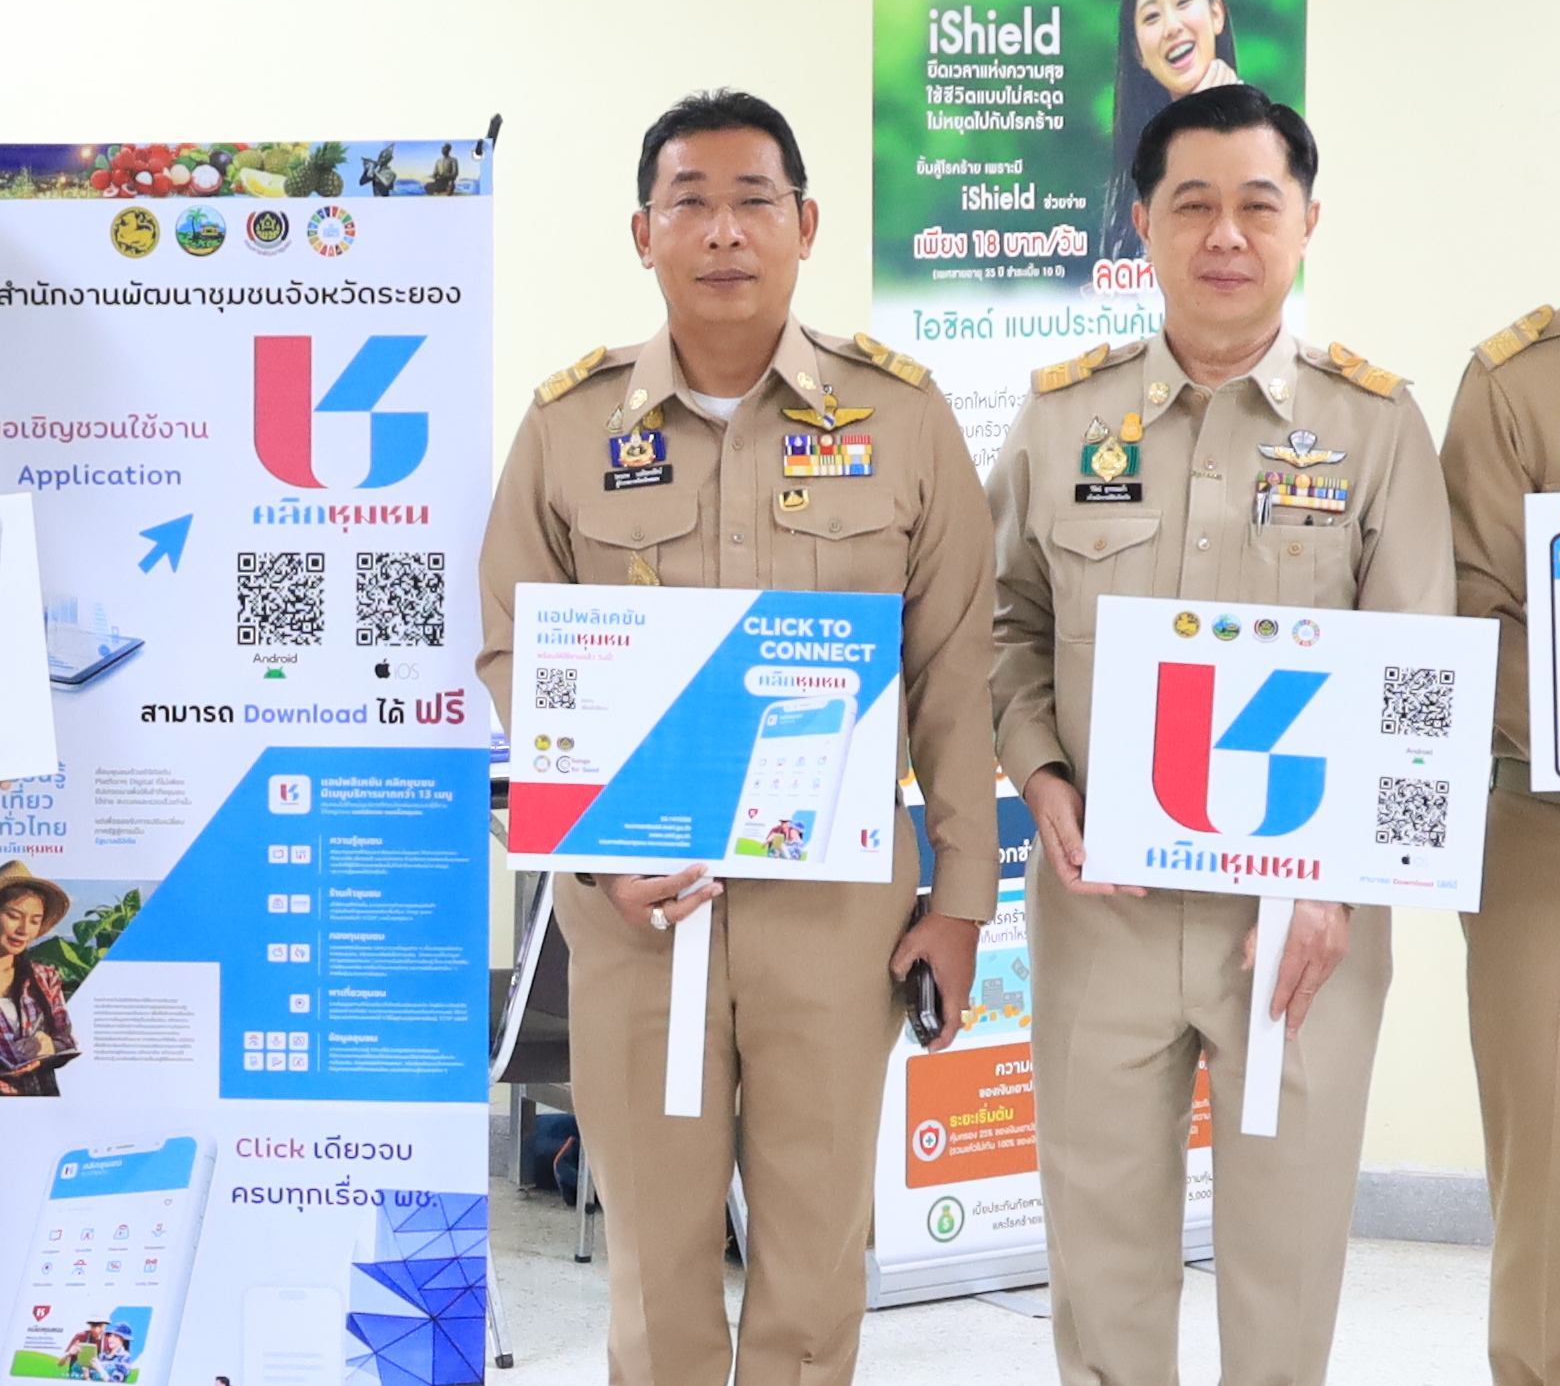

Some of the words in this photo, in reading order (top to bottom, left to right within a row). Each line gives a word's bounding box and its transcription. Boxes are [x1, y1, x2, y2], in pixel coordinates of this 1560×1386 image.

[929, 6, 1061, 56] iShield
[962, 183, 1035, 210] iShield
[914, 225, 968, 259] เพียง
[972, 229, 999, 258] 18
[1004, 224, 1088, 257] บาท/วัน
[18, 465, 182, 491] Application
[253, 497, 430, 534] คลิกชุมชน
[537, 608, 645, 626] แอปพลิเคชัน
[744, 617, 815, 637] CLICK
[818, 619, 852, 637] TO
[253, 652, 298, 665] Android
[760, 641, 875, 663] CONNECT
[758, 671, 846, 692] คลิกชุมชน
[141, 700, 234, 725] สามารถ
[244, 704, 367, 725] Download
[378, 697, 405, 725] ได้
[416, 688, 465, 726] ฟรี
[1, 783, 54, 810] เที่ยว
[418, 790, 431, 799] 13
[1146, 841, 1321, 885] คลิกชุมชน
[949, 1102, 1014, 1127] ระยะเริ่มต้น
[236, 1137, 305, 1160] Click
[313, 1133, 412, 1161] เดียวจบ
[231, 1176, 384, 1212] ครบทุกเรื่อง
